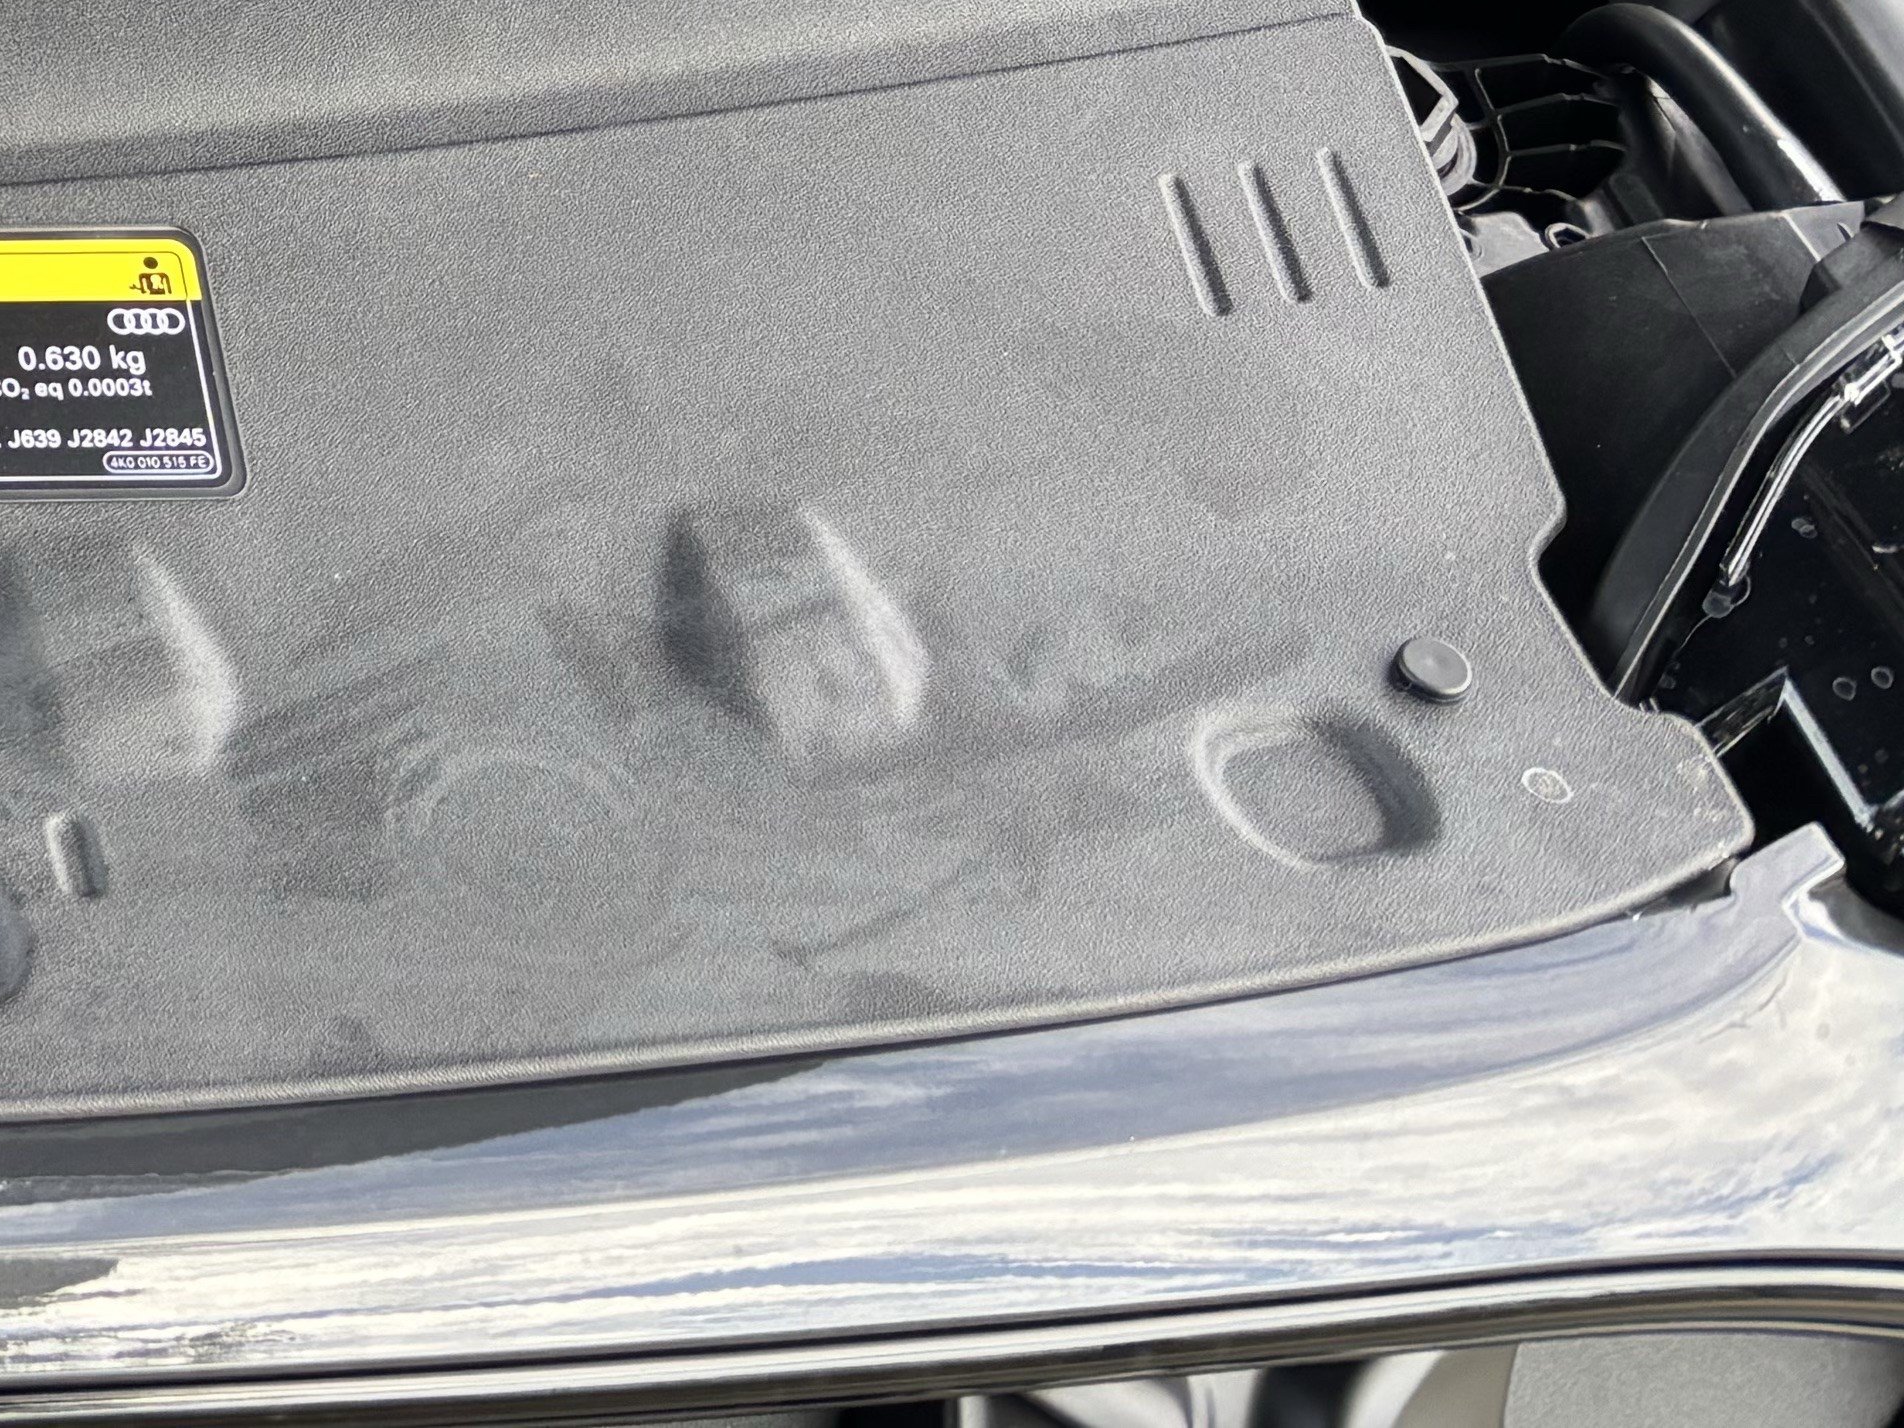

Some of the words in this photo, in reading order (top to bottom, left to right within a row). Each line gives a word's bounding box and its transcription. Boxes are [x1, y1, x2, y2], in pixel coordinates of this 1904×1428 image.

[18, 346, 102, 371] 0.630
[111, 346, 146, 376] kg
[35, 380, 64, 401] eq
[68, 377, 152, 397] 0.0003t
[8, 428, 60, 449] J639
[68, 428, 133, 449] J2842
[139, 427, 207, 447] J2845
[111, 456, 135, 468] 4K0
[138, 456, 160, 468] 010
[163, 456, 187, 468] 515
[190, 456, 207, 468] FE
